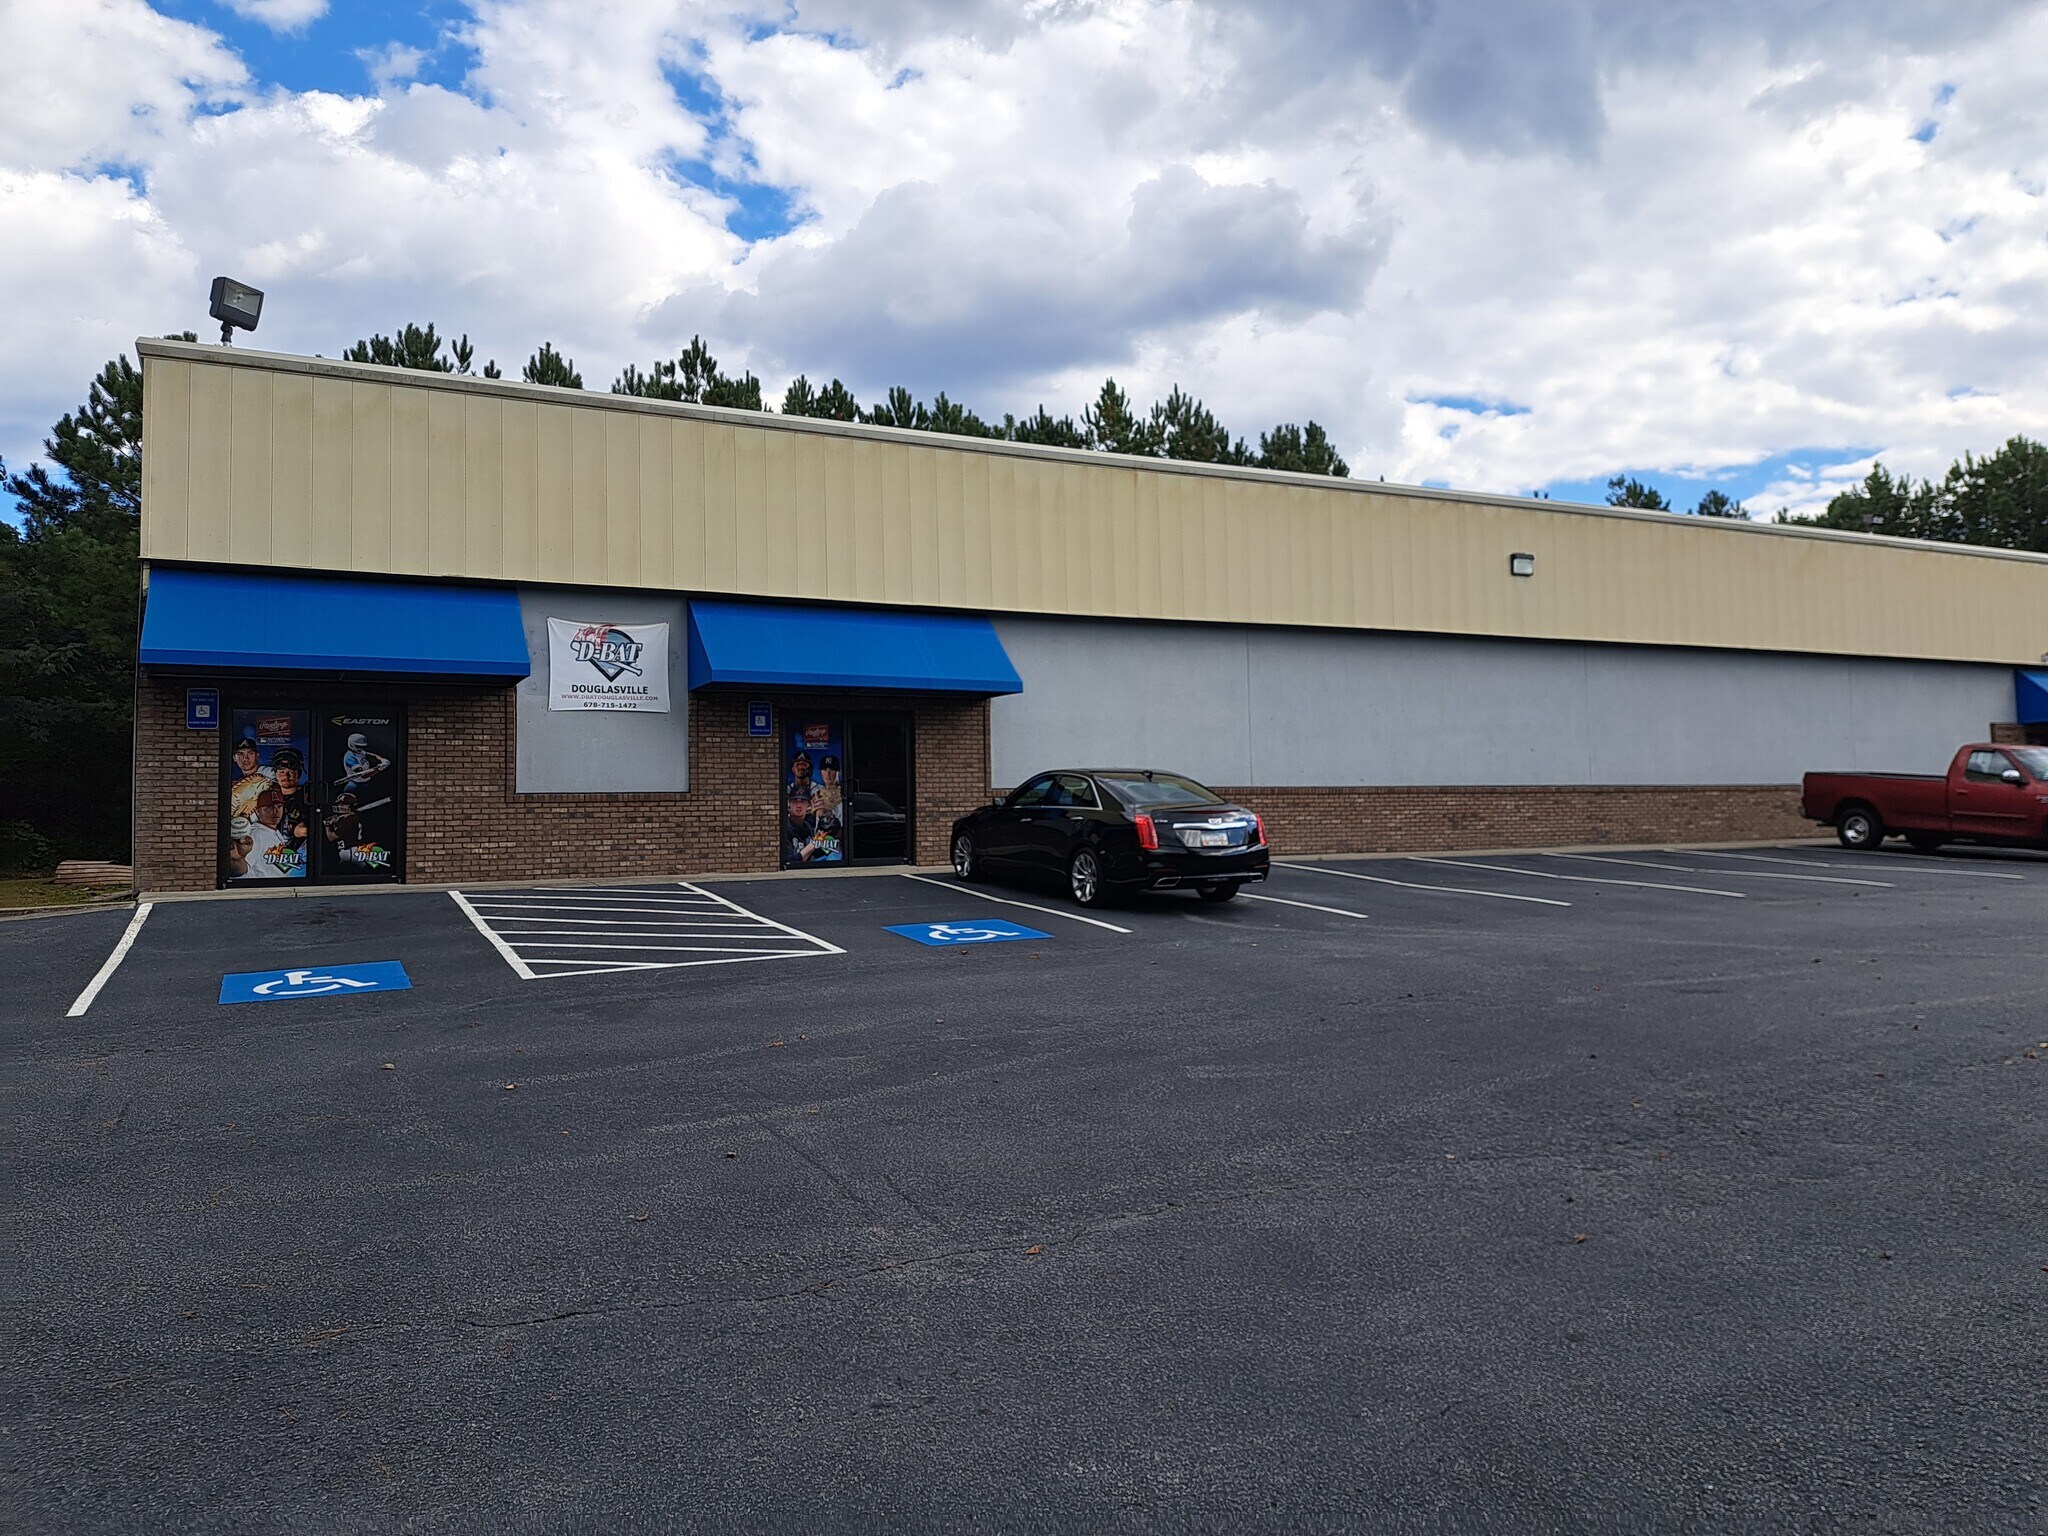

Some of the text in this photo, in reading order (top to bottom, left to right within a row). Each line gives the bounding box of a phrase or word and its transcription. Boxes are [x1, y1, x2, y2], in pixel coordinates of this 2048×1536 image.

[575, 641, 643, 662] D-BAT
[571, 684, 649, 695] DOUGLASVILLE
[560, 693, 659, 701] WWW.DBATDOUGLASVILLE.COM
[583, 701, 637, 709] 678-715-1472
[265, 853, 302, 865] D-BAT
[356, 850, 391, 863] D-BAT
